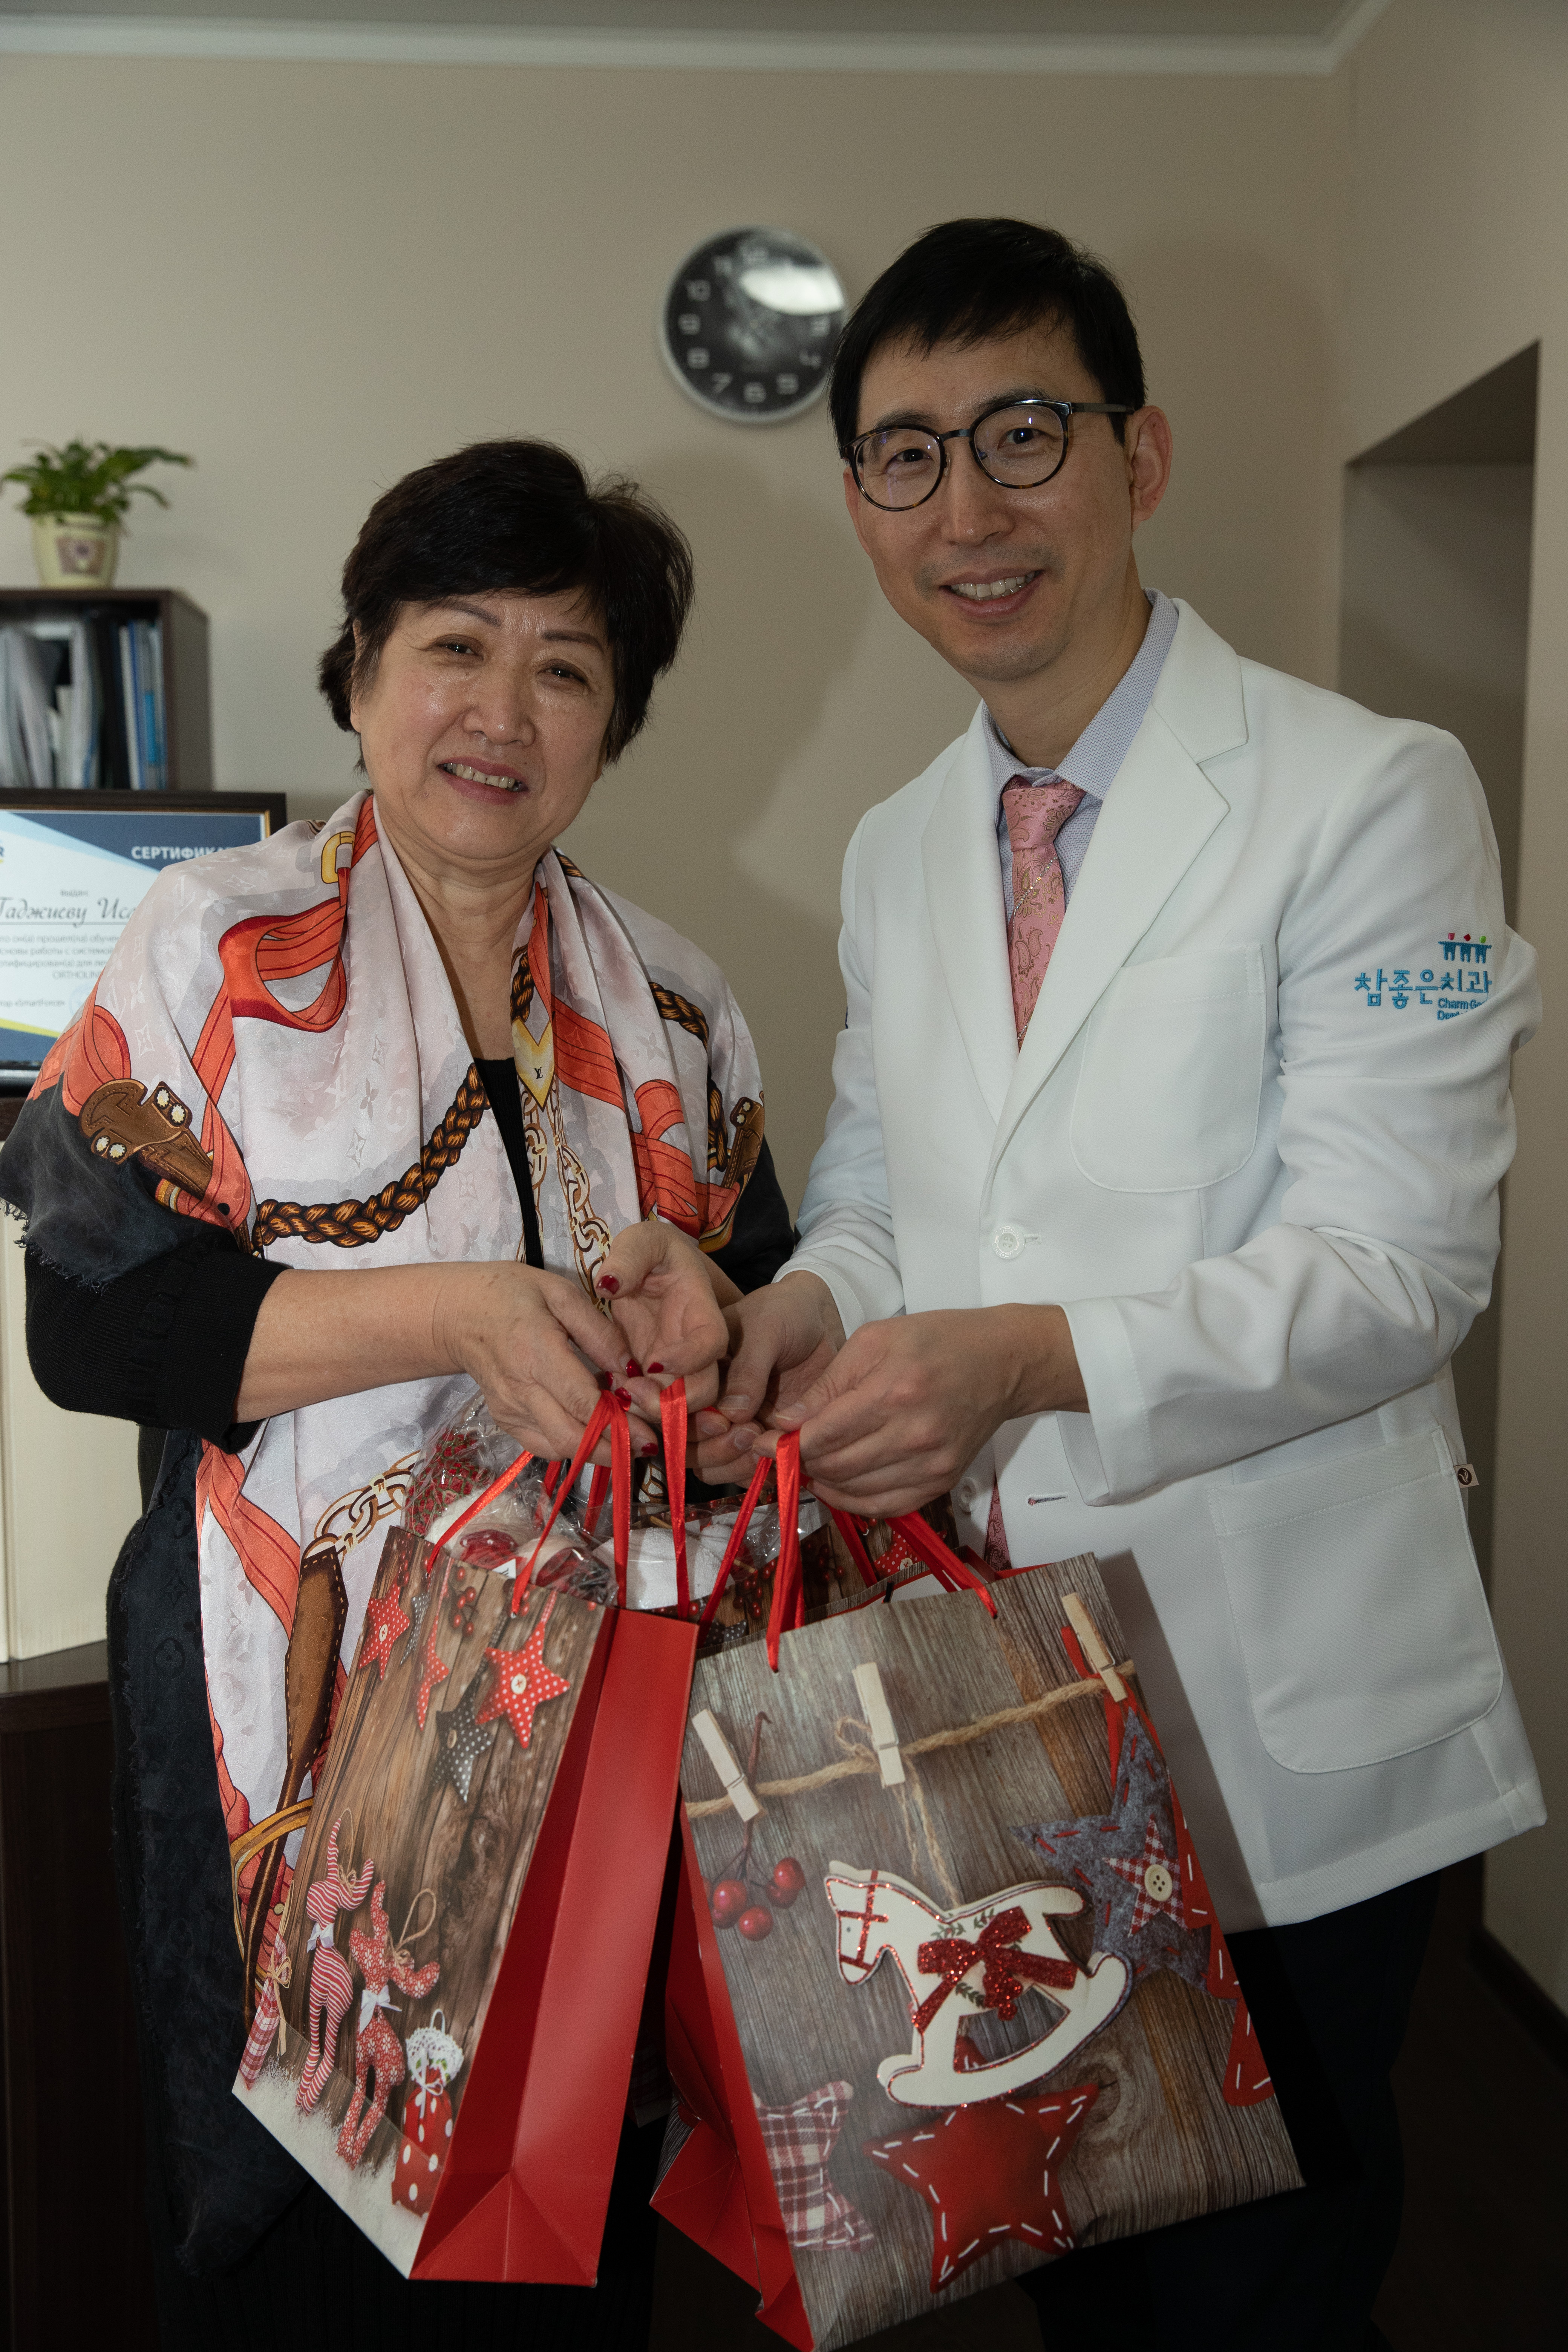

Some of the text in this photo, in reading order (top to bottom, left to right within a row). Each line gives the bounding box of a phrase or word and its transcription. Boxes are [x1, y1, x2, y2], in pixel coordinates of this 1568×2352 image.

[686, 280, 709, 300] 10
[679, 315, 700, 334] 9
[688, 349, 709, 368] 8
[713, 373, 732, 393] 7
[1354, 969, 1492, 1009] 참좋은치과
[1438, 998, 1468, 1009] Charm
